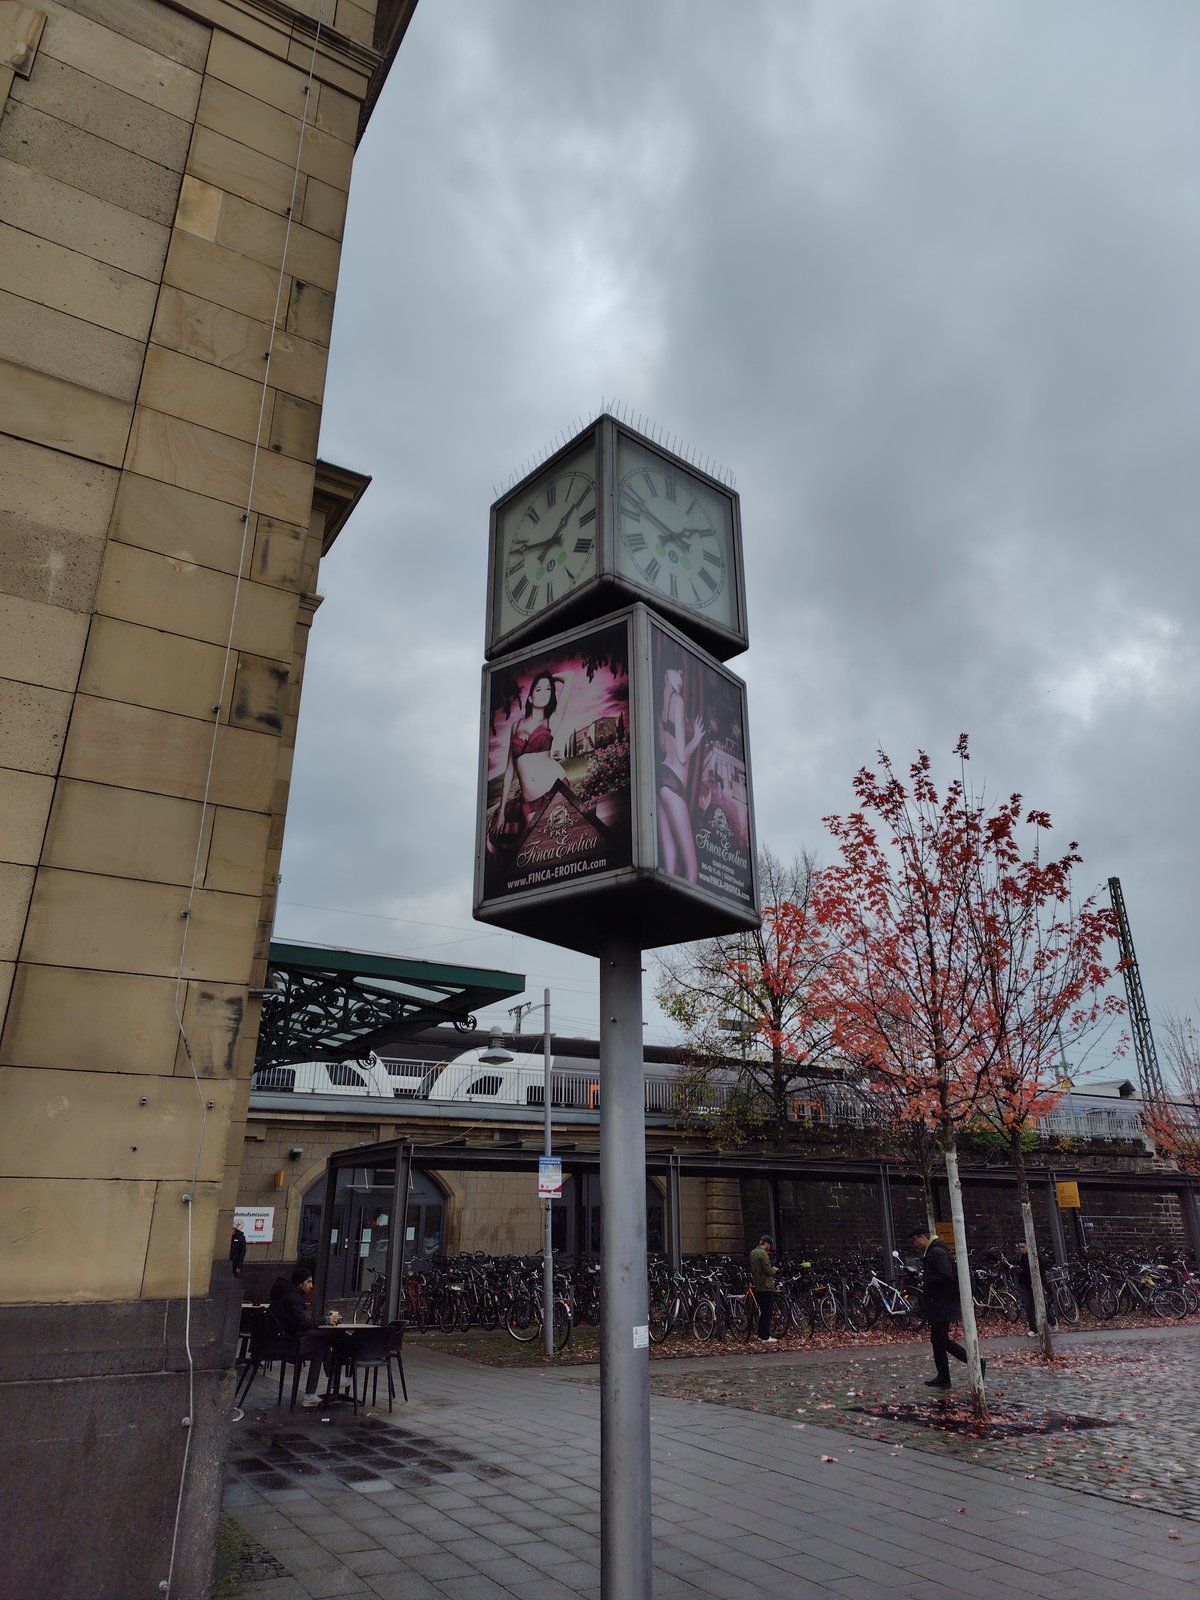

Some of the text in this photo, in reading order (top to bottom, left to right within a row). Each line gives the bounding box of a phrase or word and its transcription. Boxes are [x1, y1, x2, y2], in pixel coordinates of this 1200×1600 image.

[549, 827, 567, 838] FKK
[516, 833, 598, 868] Finca Erotica
[696, 829, 721, 857] Finca
[721, 838, 747, 870] Erotica
[507, 858, 607, 889] www.FINCA-EROTICA.com
